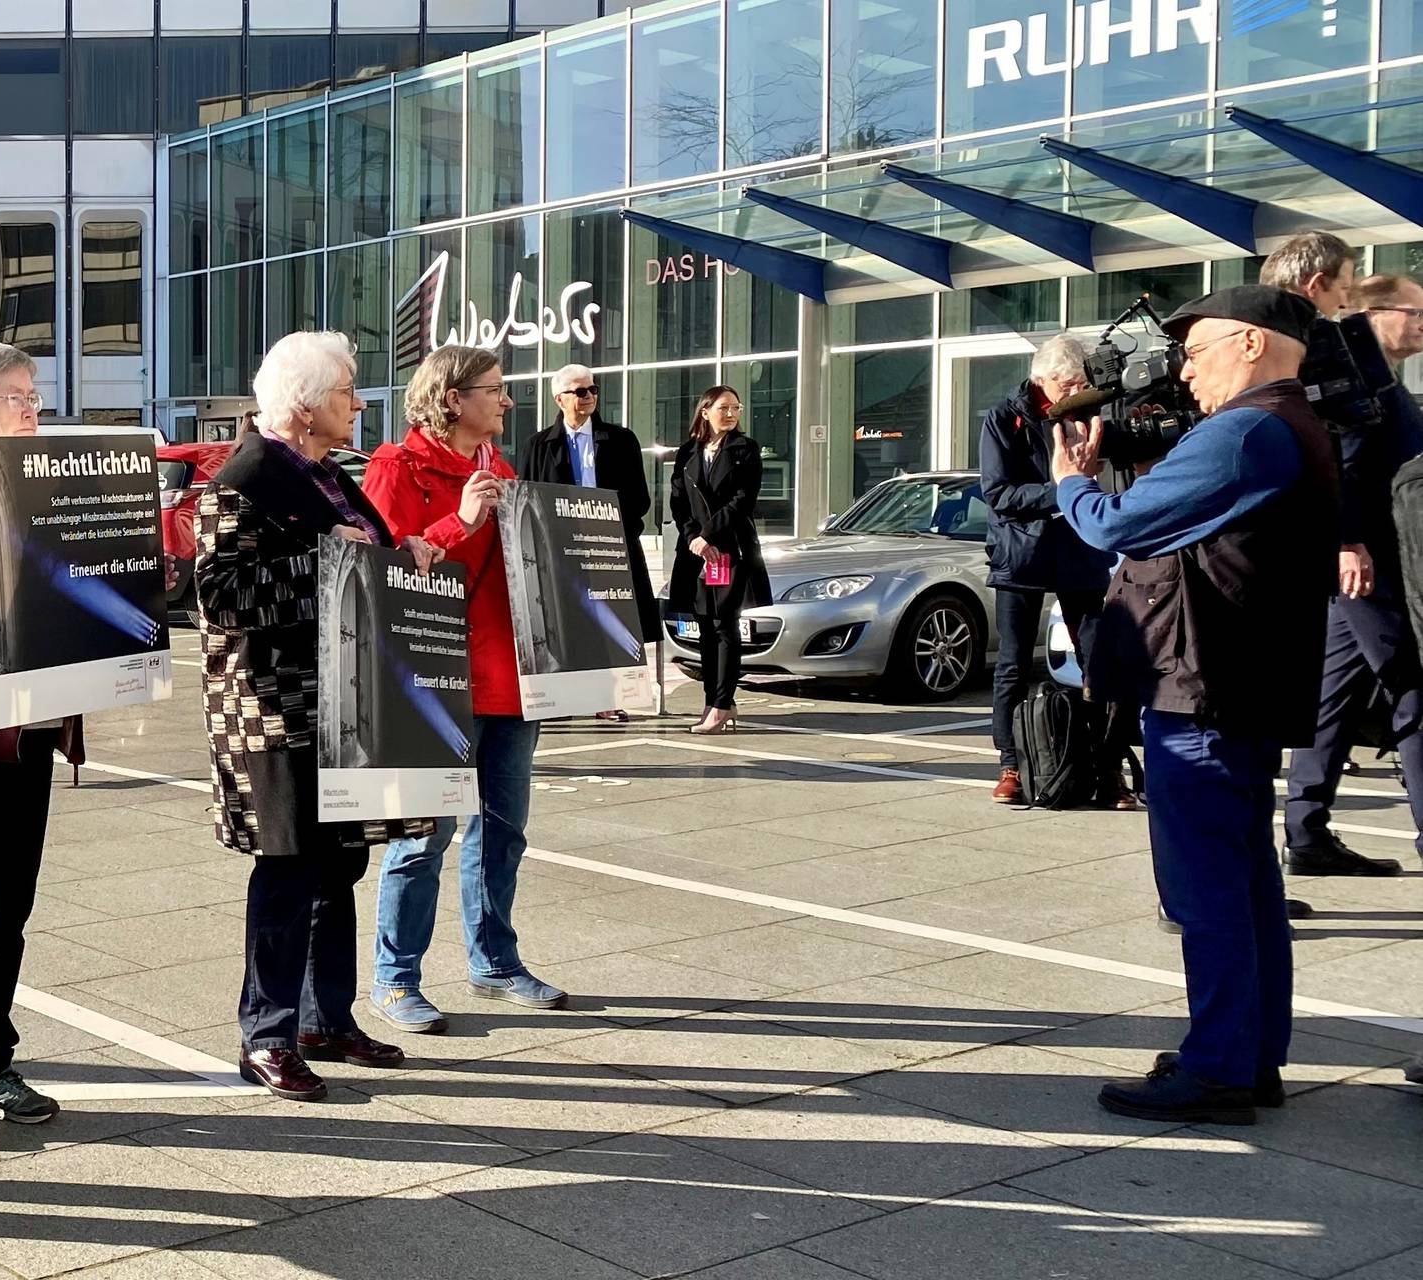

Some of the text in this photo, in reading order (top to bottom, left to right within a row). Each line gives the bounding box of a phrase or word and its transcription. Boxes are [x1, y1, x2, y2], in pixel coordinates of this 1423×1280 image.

[967, 0, 1222, 88] RUHR
[646, 254, 694, 285] DAS
[23, 450, 152, 478] #MachtLichtAn
[101, 493, 144, 504] Machtstrukturen
[555, 498, 620, 521] #MachtLichtAn
[47, 514, 81, 526] unabhängige
[61, 531, 87, 542] Verändert
[88, 529, 96, 540] die
[122, 524, 156, 537] Sexualmoral!
[69, 556, 157, 578] Erneuert die Kirche!
[386, 565, 465, 600] #MachtLichtAn
